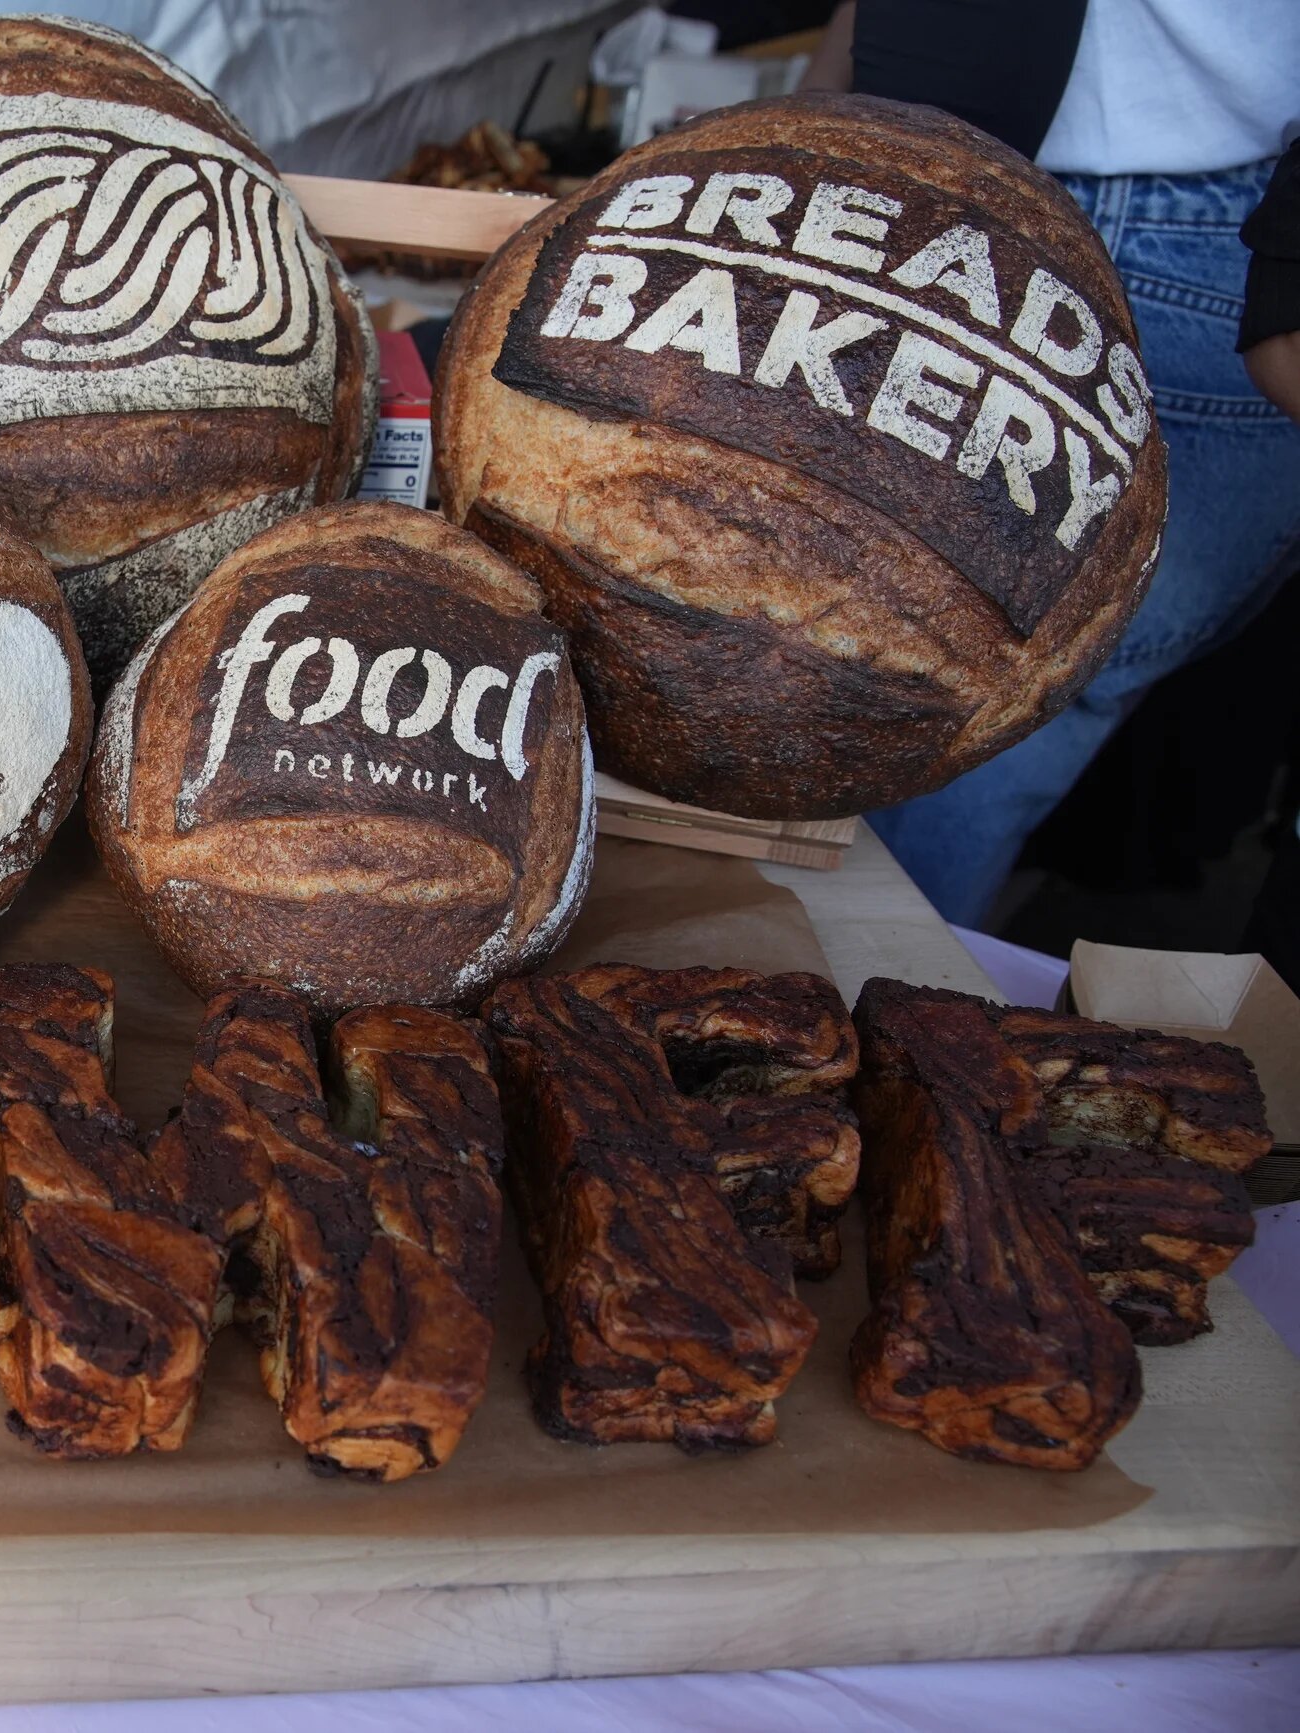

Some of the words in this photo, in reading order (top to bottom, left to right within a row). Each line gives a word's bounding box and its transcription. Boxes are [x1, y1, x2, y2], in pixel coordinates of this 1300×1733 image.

[540, 253, 1132, 551] BAKERY
[596, 172, 1153, 448] BREADS
[385, 429, 423, 441] Facts
[175, 594, 562, 832] food
[274, 749, 488, 813] network
